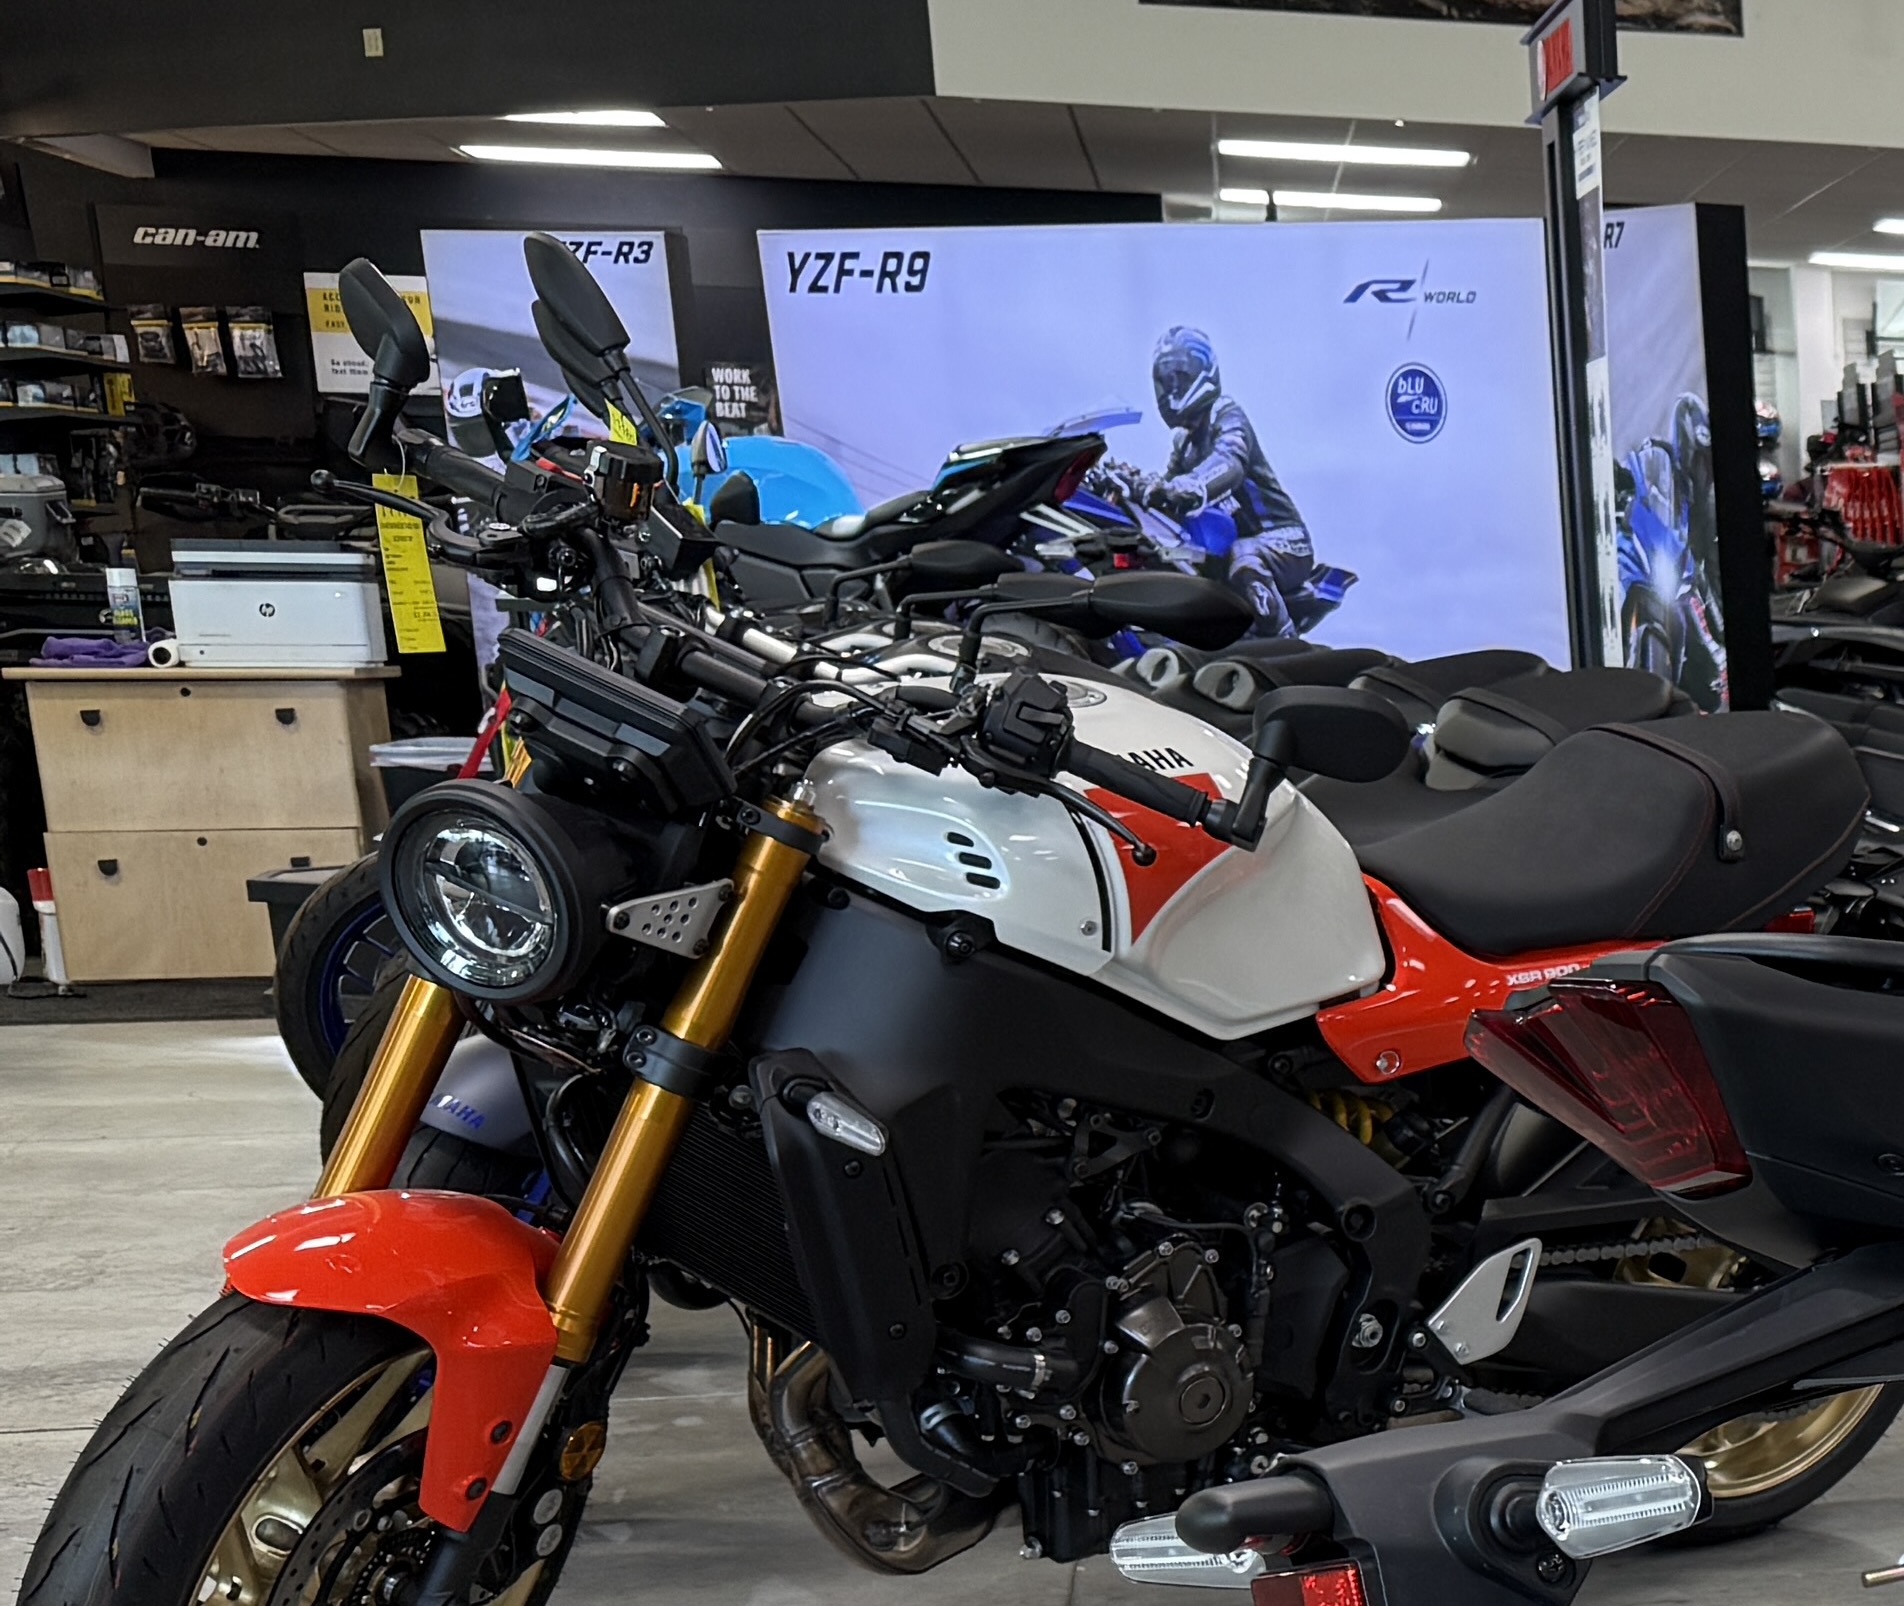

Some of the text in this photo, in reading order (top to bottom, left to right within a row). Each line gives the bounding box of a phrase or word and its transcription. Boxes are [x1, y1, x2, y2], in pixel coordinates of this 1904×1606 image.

[786, 251, 931, 294] YZF-R9
[1424, 291, 1477, 304] WORLD
[712, 368, 751, 384] WORK
[714, 386, 759, 402] TO THE
[715, 402, 747, 418] BEAT
[1127, 747, 1194, 771] AHA
